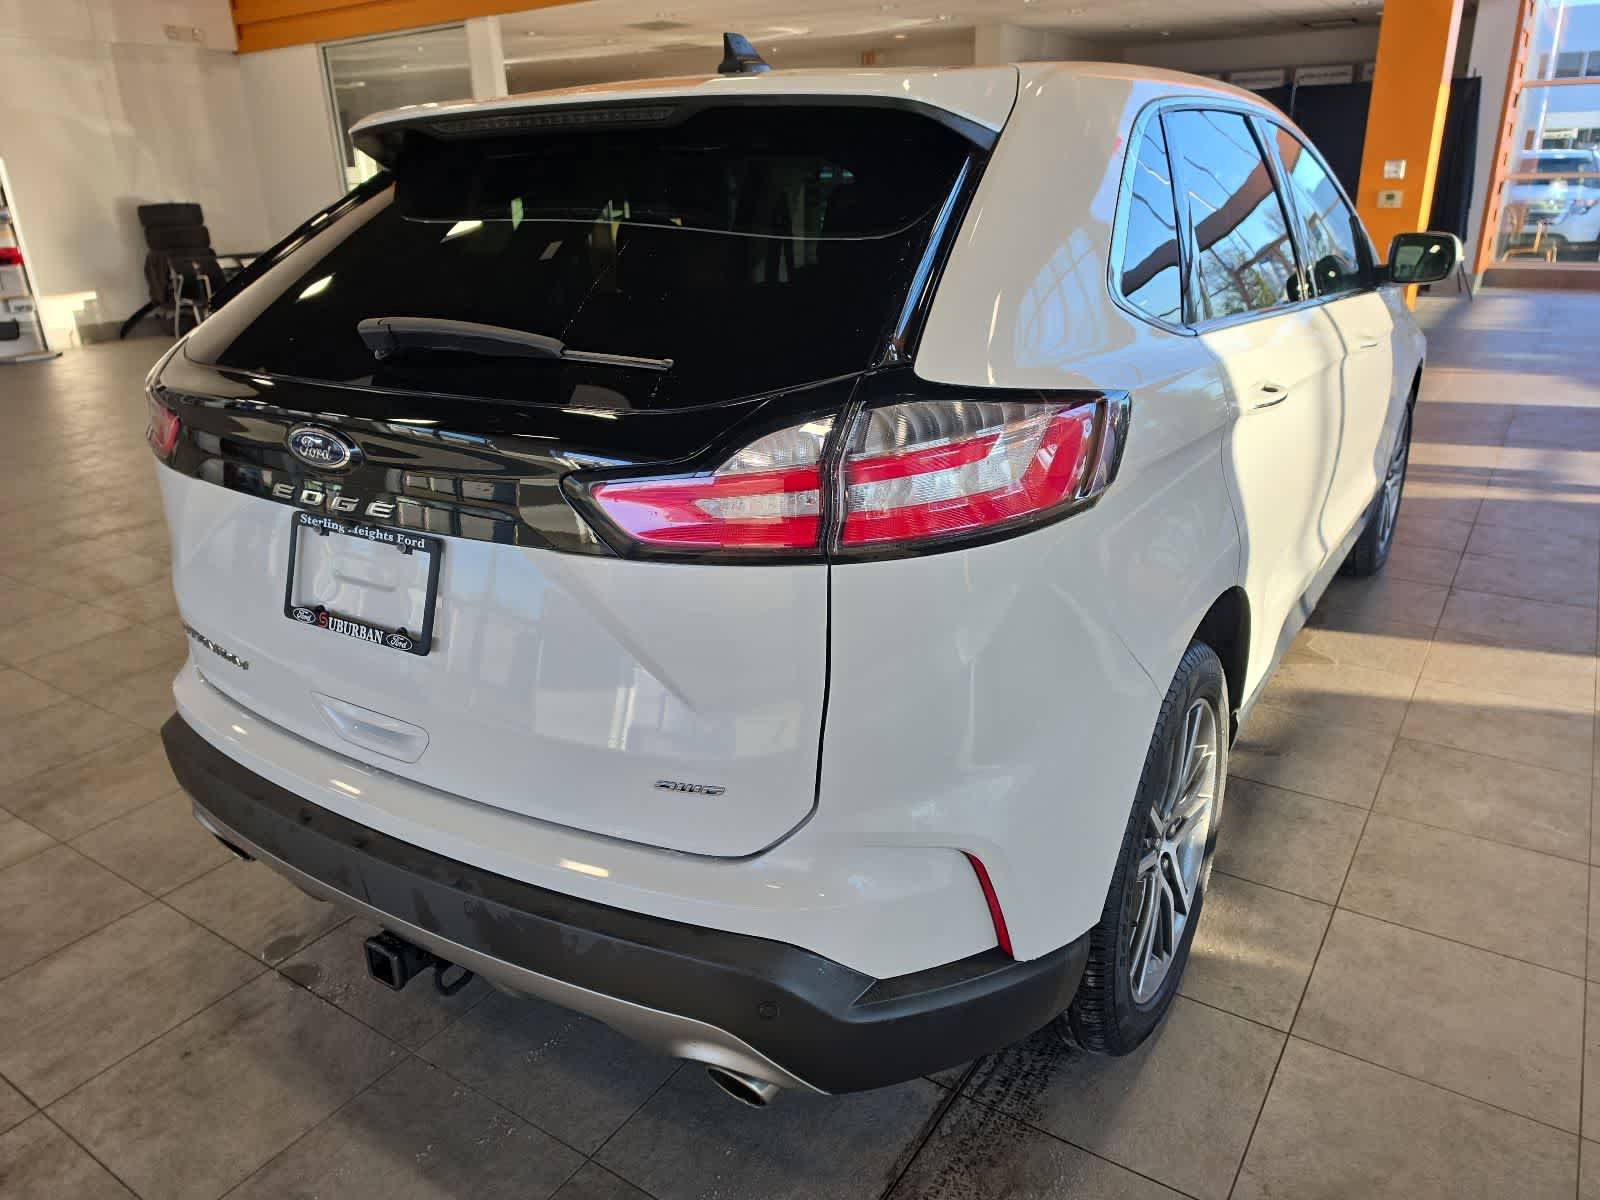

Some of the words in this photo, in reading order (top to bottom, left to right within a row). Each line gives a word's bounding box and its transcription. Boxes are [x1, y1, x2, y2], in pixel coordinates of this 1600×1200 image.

[299, 435, 332, 461] Ford
[272, 483, 396, 518] EDGE
[300, 513, 345, 534] Sterling
[396, 533, 425, 548] Ford
[319, 611, 384, 644] SUBURBAN
[390, 634, 409, 649] Ford
